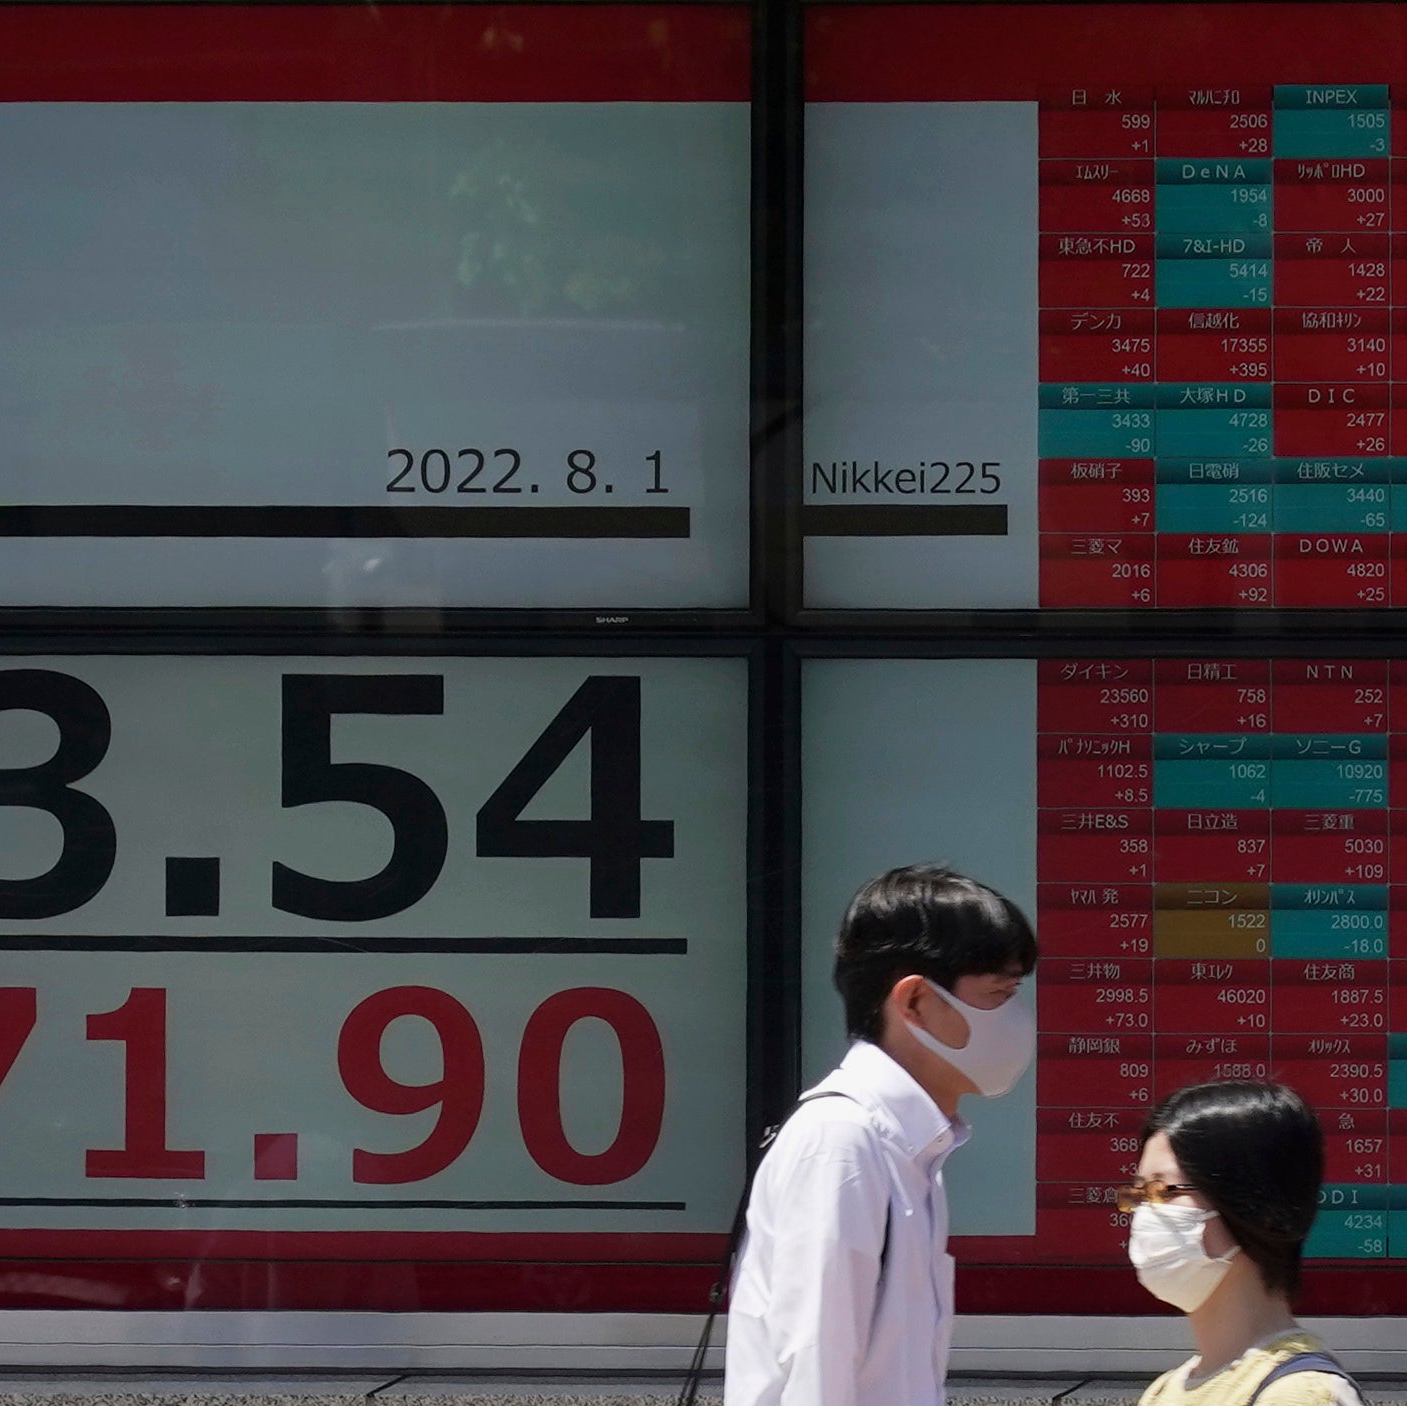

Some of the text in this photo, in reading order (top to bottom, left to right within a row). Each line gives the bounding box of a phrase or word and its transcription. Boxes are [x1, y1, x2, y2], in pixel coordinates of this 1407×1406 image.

[1305, 89, 1358, 105] INPEX
[1347, 112, 1385, 129] 1505
[1369, 137, 1386, 153] -3
[1058, 237, 1136, 256] 東急不HD
[1183, 238, 1246, 254] 7&I-HD
[1121, 263, 1151, 279] 722
[1229, 262, 1269, 279] 5414
[1131, 287, 1151, 302] +4
[1242, 286, 1268, 303] -15
[1061, 386, 1131, 405] 第一三共
[1112, 413, 1151, 429] 3433
[1125, 437, 1151, 453] -90
[812, 460, 1002, 495] Nikkei225
[1188, 537, 1239, 555] 住友鉱
[1228, 562, 1268, 578] 4306
[1238, 587, 1268, 602] +92
[1060, 663, 1129, 680] ダイキン
[1187, 663, 1237, 680] 日精工
[1100, 688, 1149, 704] 23560
[1237, 688, 1267, 704] 758
[1110, 713, 1149, 729] +310
[1236, 713, 1267, 728] +16
[1179, 738, 1248, 755] シャープ
[1229, 763, 1266, 779] 1062
[1250, 788, 1266, 803] -4
[1062, 813, 1129, 830] 三井E&S
[1187, 813, 1238, 830] 日立造
[1119, 838, 1149, 854] 358
[1237, 838, 1266, 854] 837
[1128, 863, 1147, 878] +1
[1246, 863, 1266, 878] +7
[1187, 889, 1238, 905] ニコン
[1228, 913, 1266, 929] 1522
[1255, 937, 1267, 953] 0
[1070, 962, 1121, 980] 三井物
[1303, 963, 1355, 981] 住友商
[1095, 987, 1149, 1004] 2998.5
[1331, 989, 1384, 1004] 1887.5
[1105, 1012, 1149, 1028] +73.0
[1339, 1012, 1384, 1028] +23.0
[1068, 1037, 1121, 1054] 静岡銀
[1119, 1062, 1149, 1078] 809
[1129, 1087, 1149, 1102] +6
